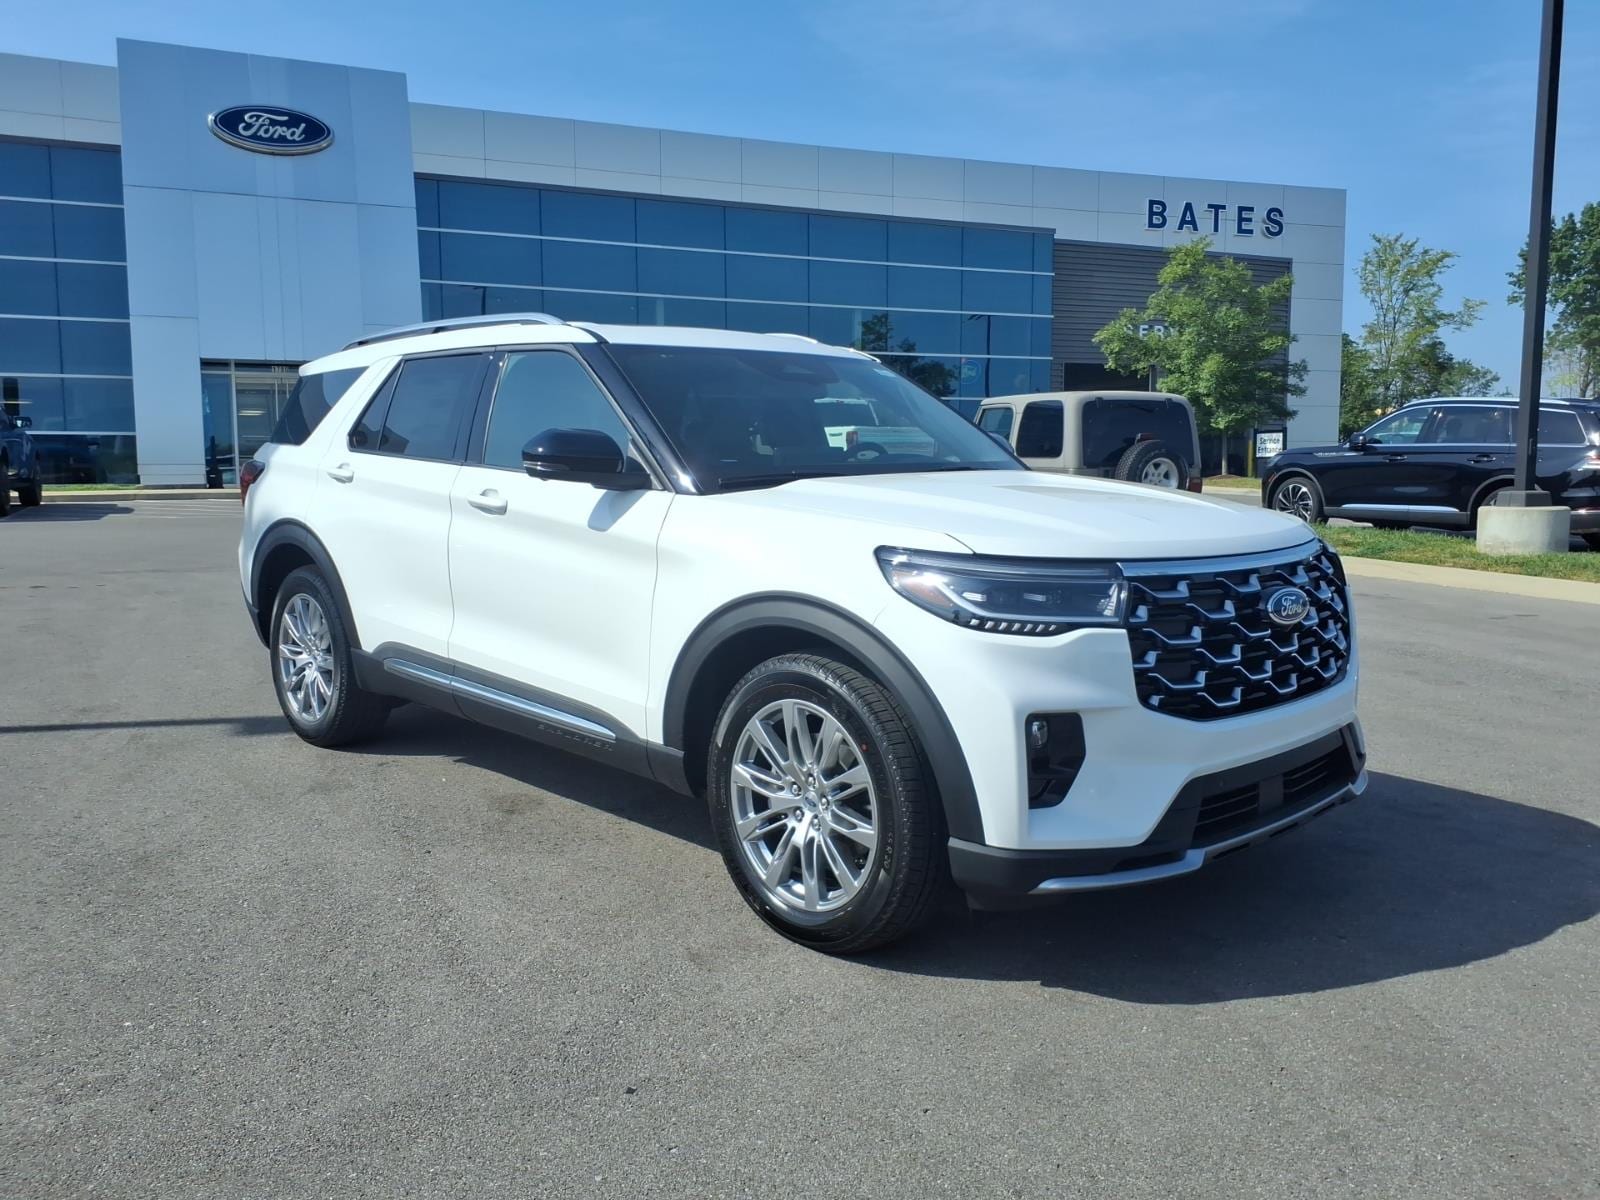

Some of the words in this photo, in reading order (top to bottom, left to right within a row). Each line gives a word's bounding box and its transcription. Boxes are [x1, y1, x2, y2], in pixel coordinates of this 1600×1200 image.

[238, 111, 307, 141] Ford
[1147, 199, 1285, 237] BATES
[1281, 596, 1303, 616] Ford
